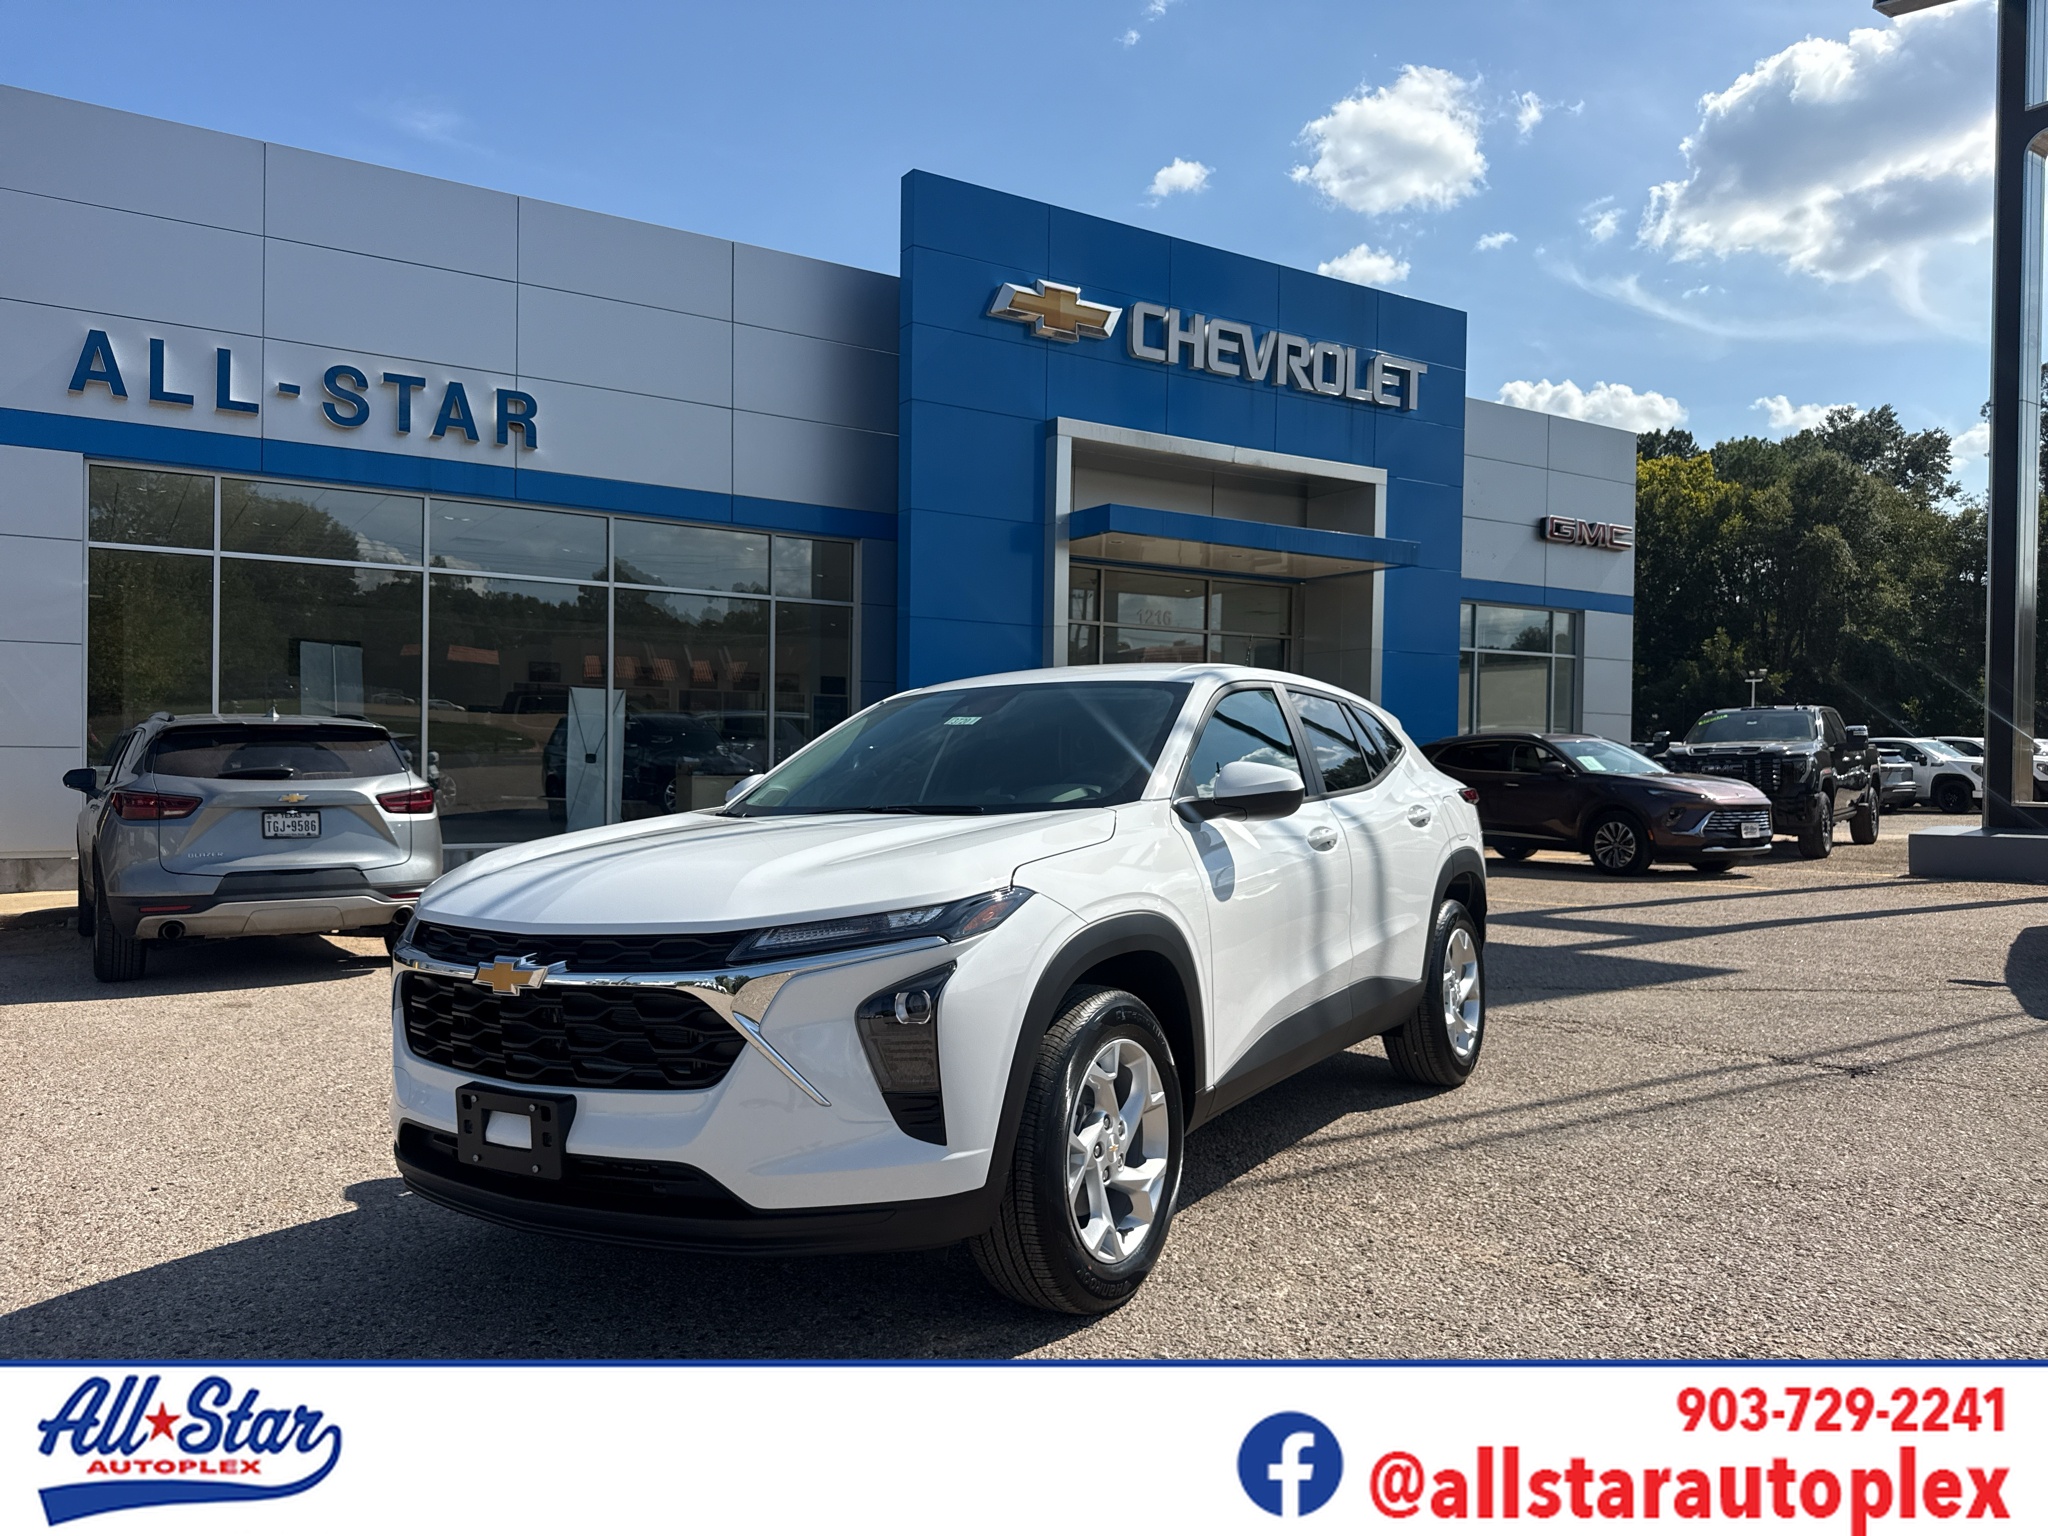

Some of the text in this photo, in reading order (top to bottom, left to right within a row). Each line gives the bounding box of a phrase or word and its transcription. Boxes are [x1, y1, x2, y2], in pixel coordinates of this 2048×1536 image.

[68, 328, 538, 450] ALL-STAR
[1127, 301, 1428, 411] CHEVROLET
[1547, 514, 1633, 551] GMC
[1136, 608, 1172, 625] 1216
